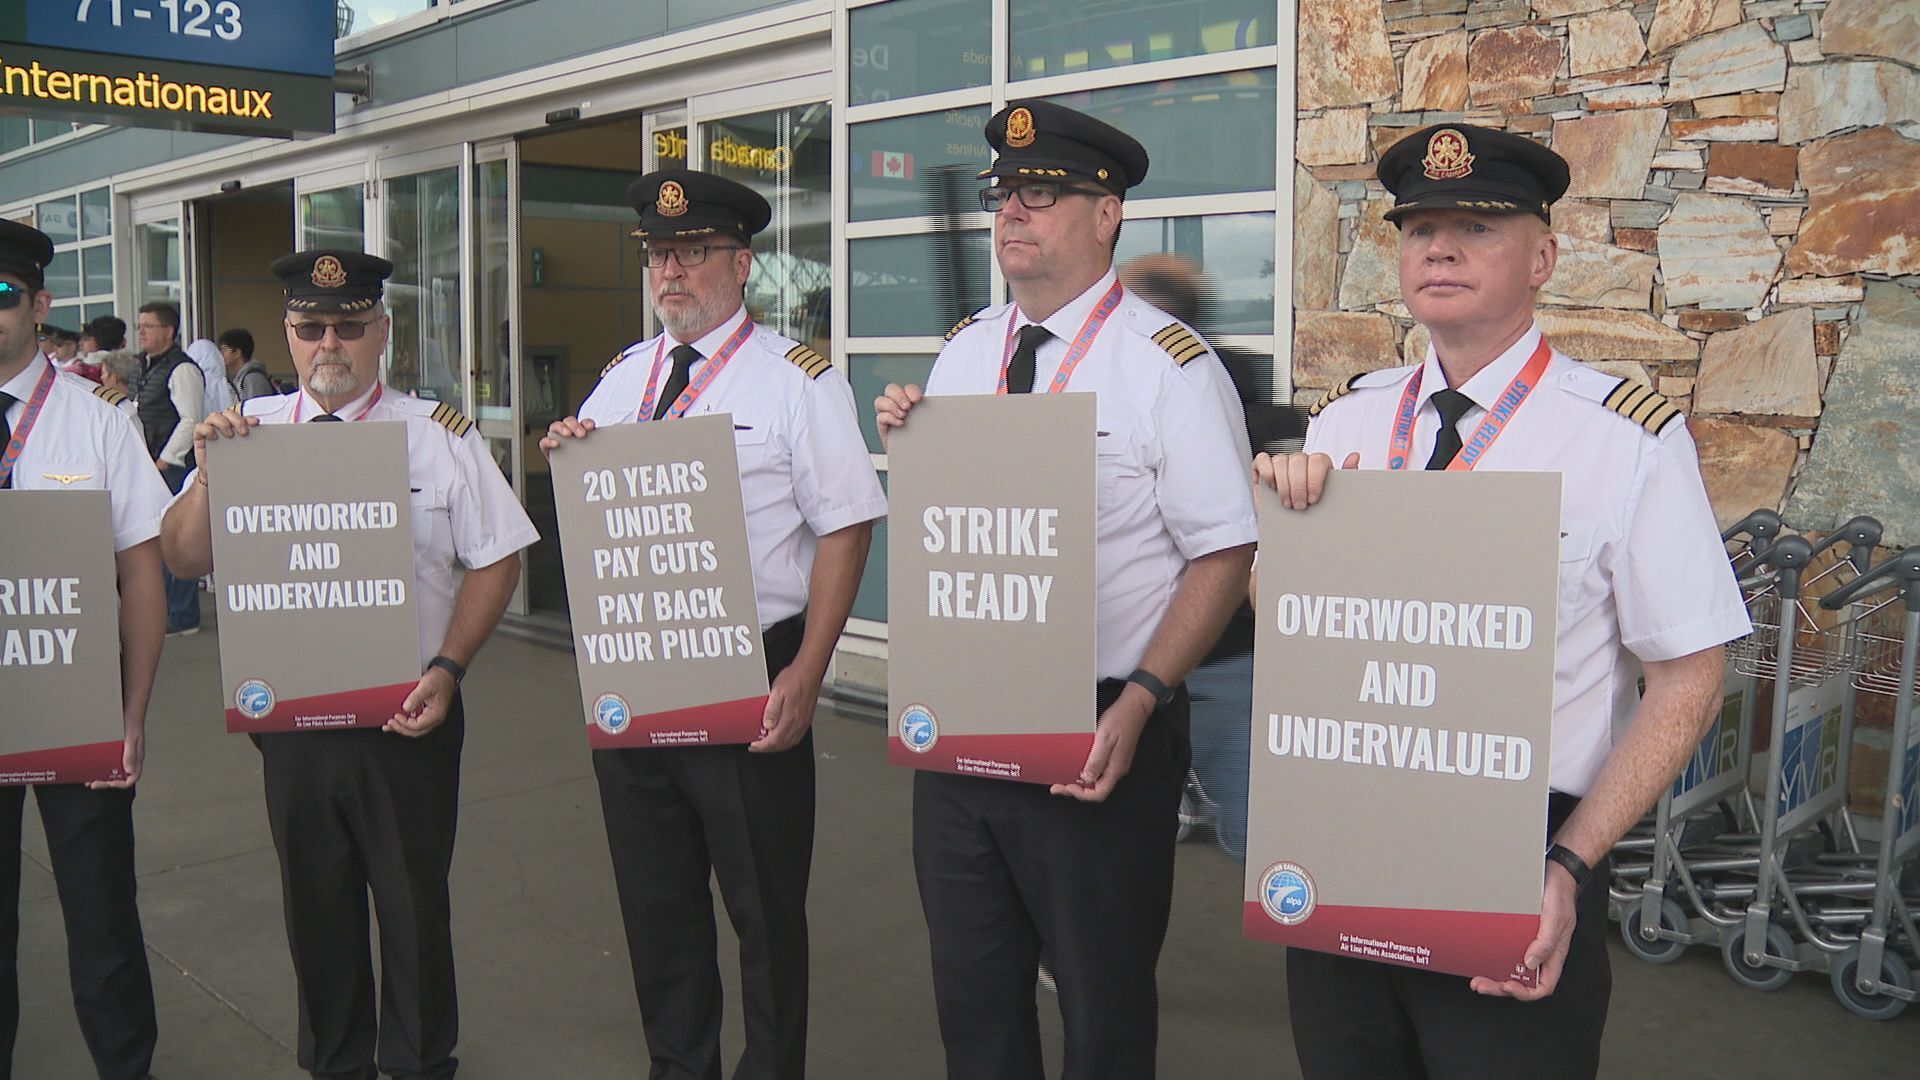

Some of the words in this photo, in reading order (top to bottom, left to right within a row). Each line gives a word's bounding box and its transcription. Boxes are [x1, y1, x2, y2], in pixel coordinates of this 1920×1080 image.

[0, 58, 273, 119] nternationaux
[1490, 379, 1529, 425] STRIKE
[1459, 421, 1498, 466] READY
[584, 469, 618, 502] 20
[623, 460, 708, 500] YEARS
[226, 500, 398, 534] OVERWORKED
[605, 502, 695, 539] UNDER
[922, 505, 1059, 557] STRIKE
[289, 542, 341, 571] AND
[593, 545, 640, 580] PAY
[649, 540, 718, 575] CUTS
[0, 577, 82, 616] RIKE
[228, 578, 405, 612] UNDERVALUED
[597, 592, 645, 626] PAY
[653, 586, 728, 621] BACK
[928, 570, 1054, 624] READY
[1277, 593, 1533, 650] OVERWORKED
[0, 628, 78, 666] ADY
[582, 632, 654, 665] YOUR
[660, 625, 753, 660] PILOTS
[1359, 660, 1436, 708] AND
[1268, 713, 1532, 781] UNDERVALUED
[1286, 896, 1302, 907] alpa
[1339, 932, 1349, 942] For
[1350, 935, 1388, 949] Informational
[1389, 941, 1415, 954] Purposes
[1416, 945, 1430, 957] Only
[1340, 943, 1349, 952] Air
[1350, 944, 1362, 954] Line
[1363, 945, 1380, 957] Pilots
[1380, 950, 1415, 963] Association,
